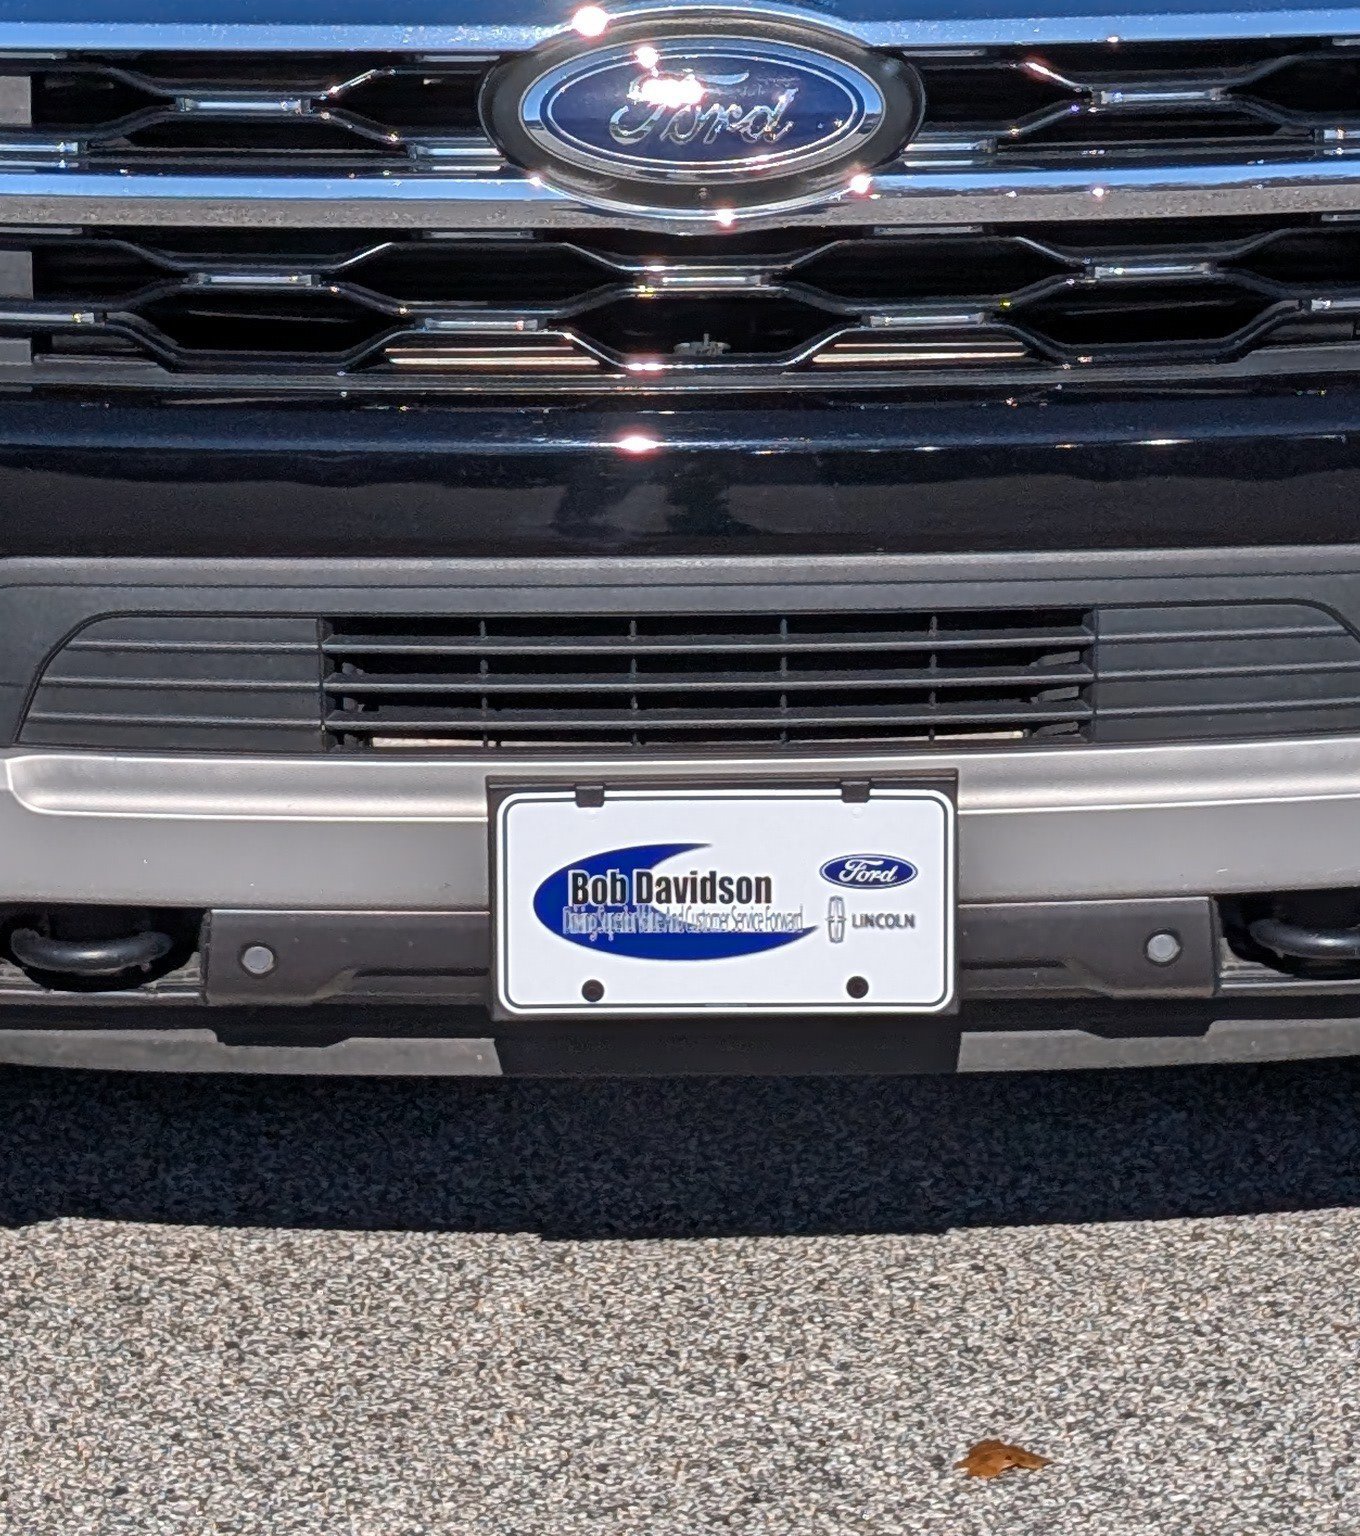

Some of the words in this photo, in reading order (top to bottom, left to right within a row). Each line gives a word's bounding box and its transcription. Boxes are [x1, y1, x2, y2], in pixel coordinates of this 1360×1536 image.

[608, 69, 798, 145] Ford
[838, 859, 899, 883] Ford
[571, 871, 627, 905] Bob
[635, 870, 772, 905] Davidson
[852, 912, 916, 929] LINCOLN
